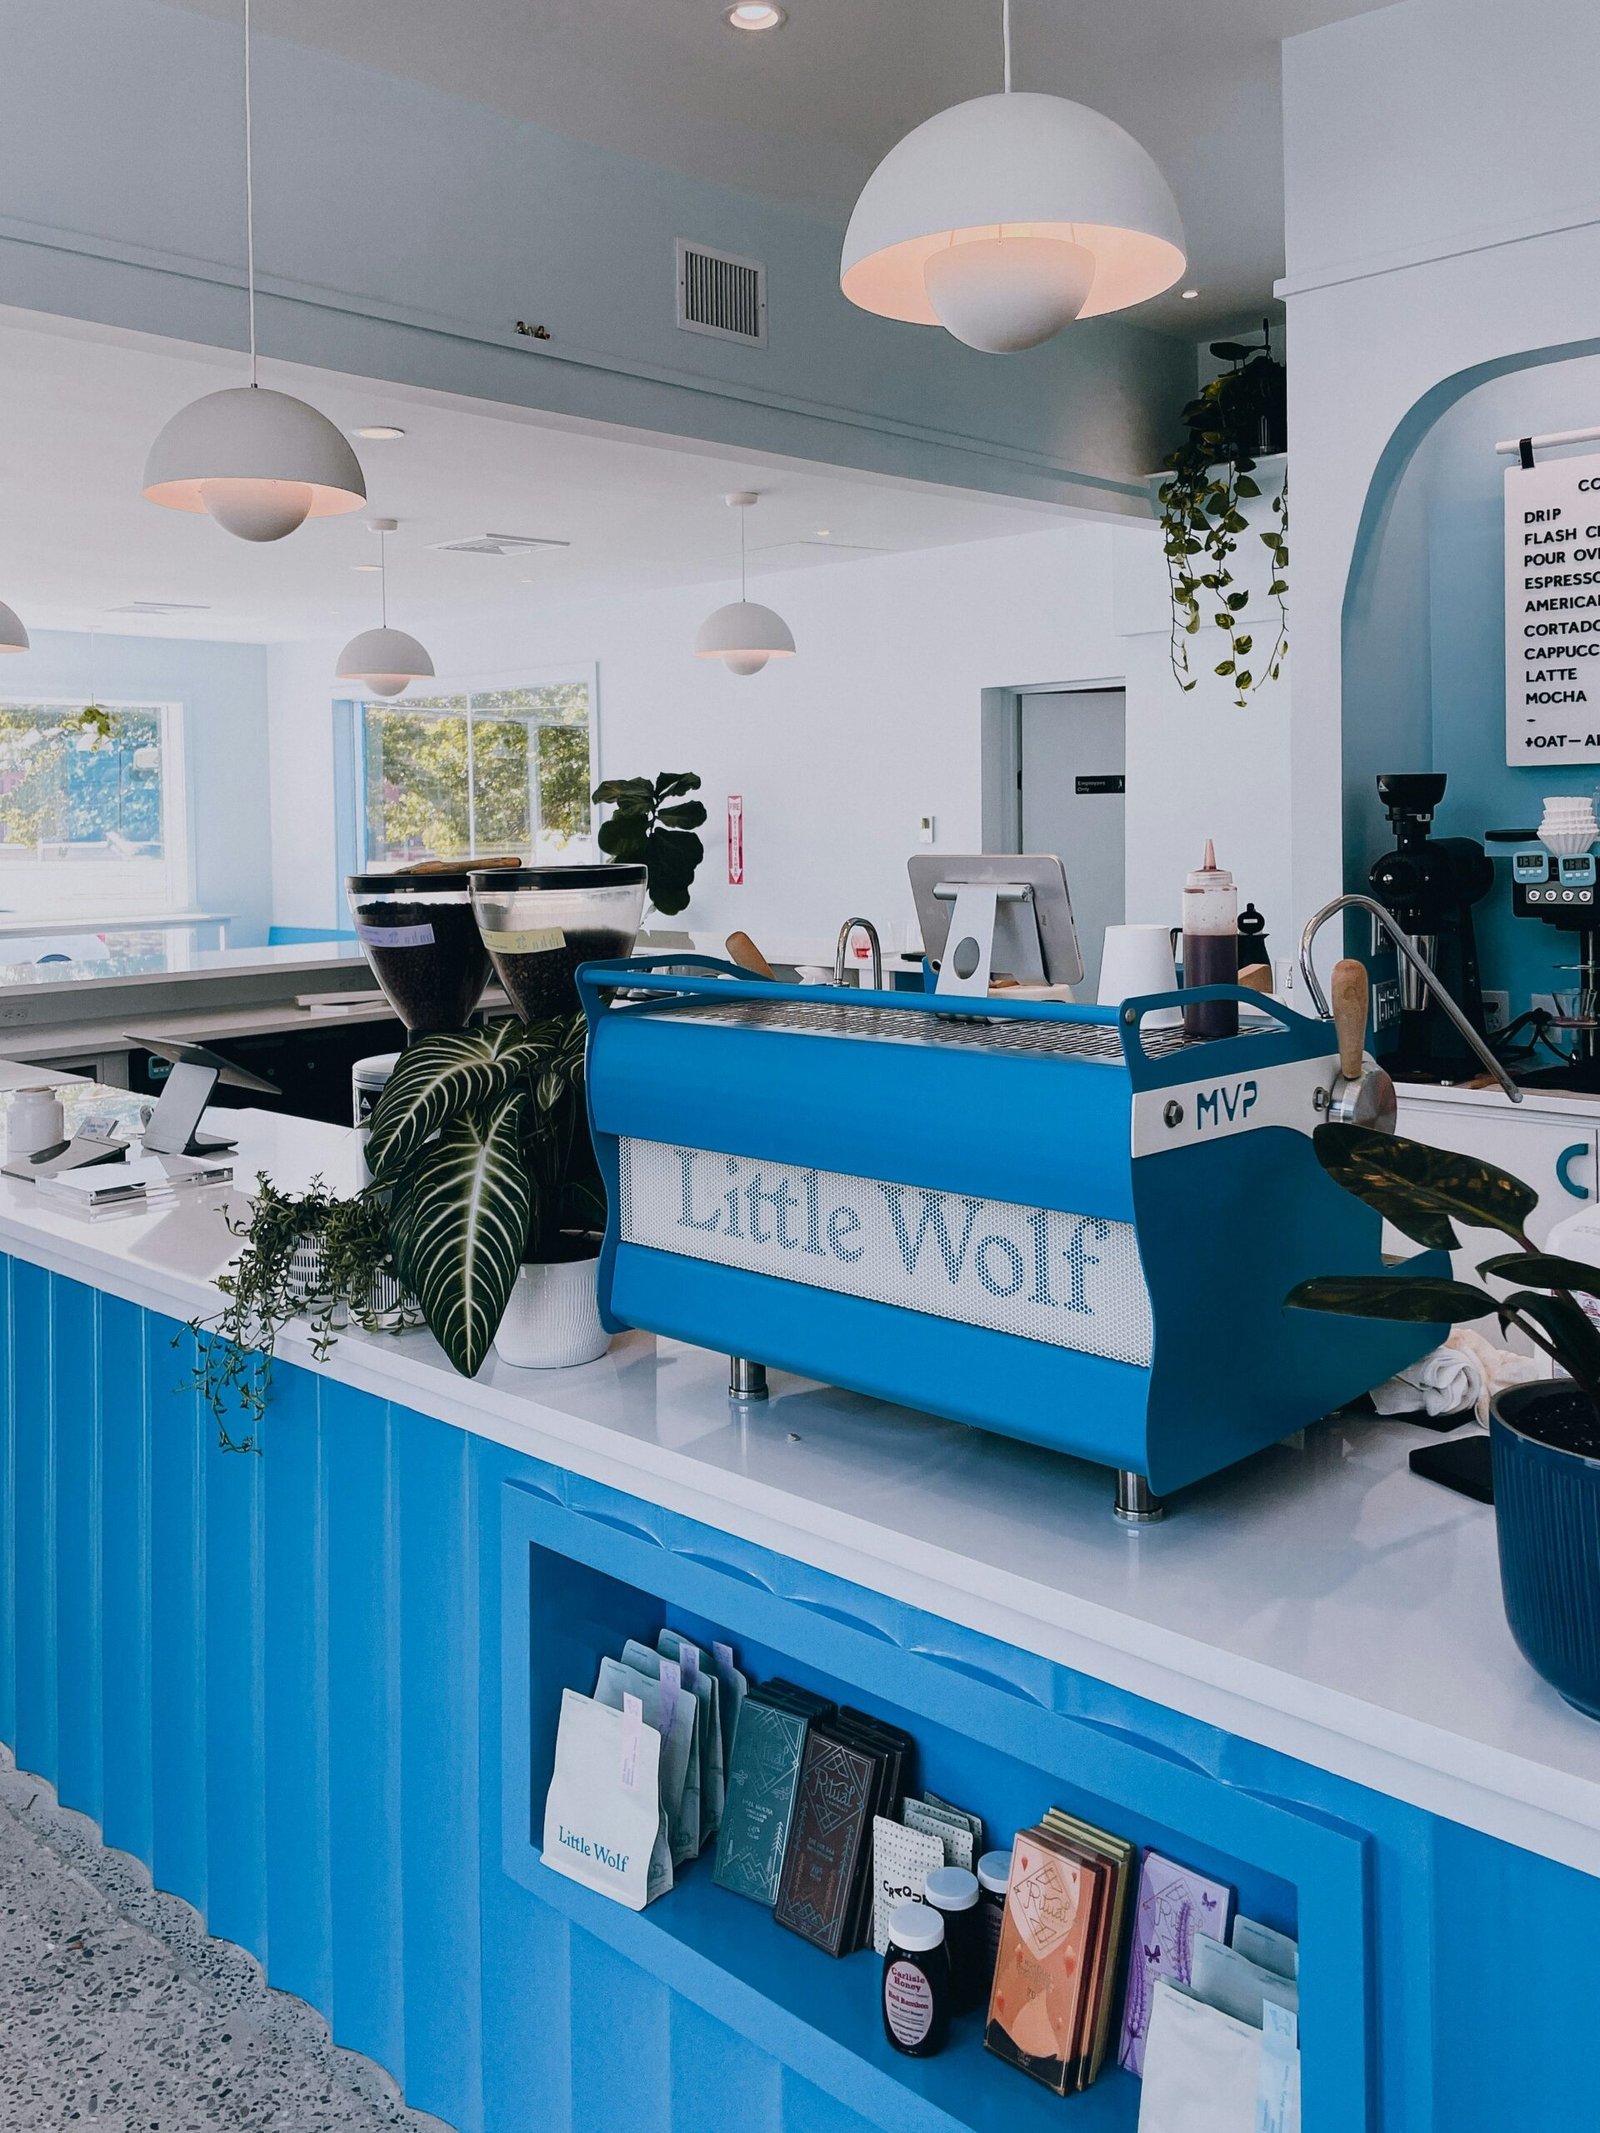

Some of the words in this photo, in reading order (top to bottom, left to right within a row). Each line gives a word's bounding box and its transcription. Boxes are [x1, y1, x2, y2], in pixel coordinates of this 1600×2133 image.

[1524, 508, 1561, 523] DRIP
[1525, 528, 1577, 545] FLASH
[1586, 525, 1600, 538] C
[1524, 551, 1565, 567] POUR
[1574, 548, 1600, 561] OV
[1525, 594, 1600, 612] AMERICA
[1526, 668, 1577, 682] LATTE
[1526, 690, 1587, 705] MOCHA
[1197, 1080, 1258, 1130] MVP
[674, 1149, 865, 1264] Little
[876, 1183, 1111, 1316] Wolf
[558, 1825, 591, 1856] Little
[593, 1843, 630, 1872] Wolf
[1023, 1880, 1071, 1923] Ritual
[891, 1967, 926, 1984] Carlisle
[894, 1976, 921, 1993] Honey
